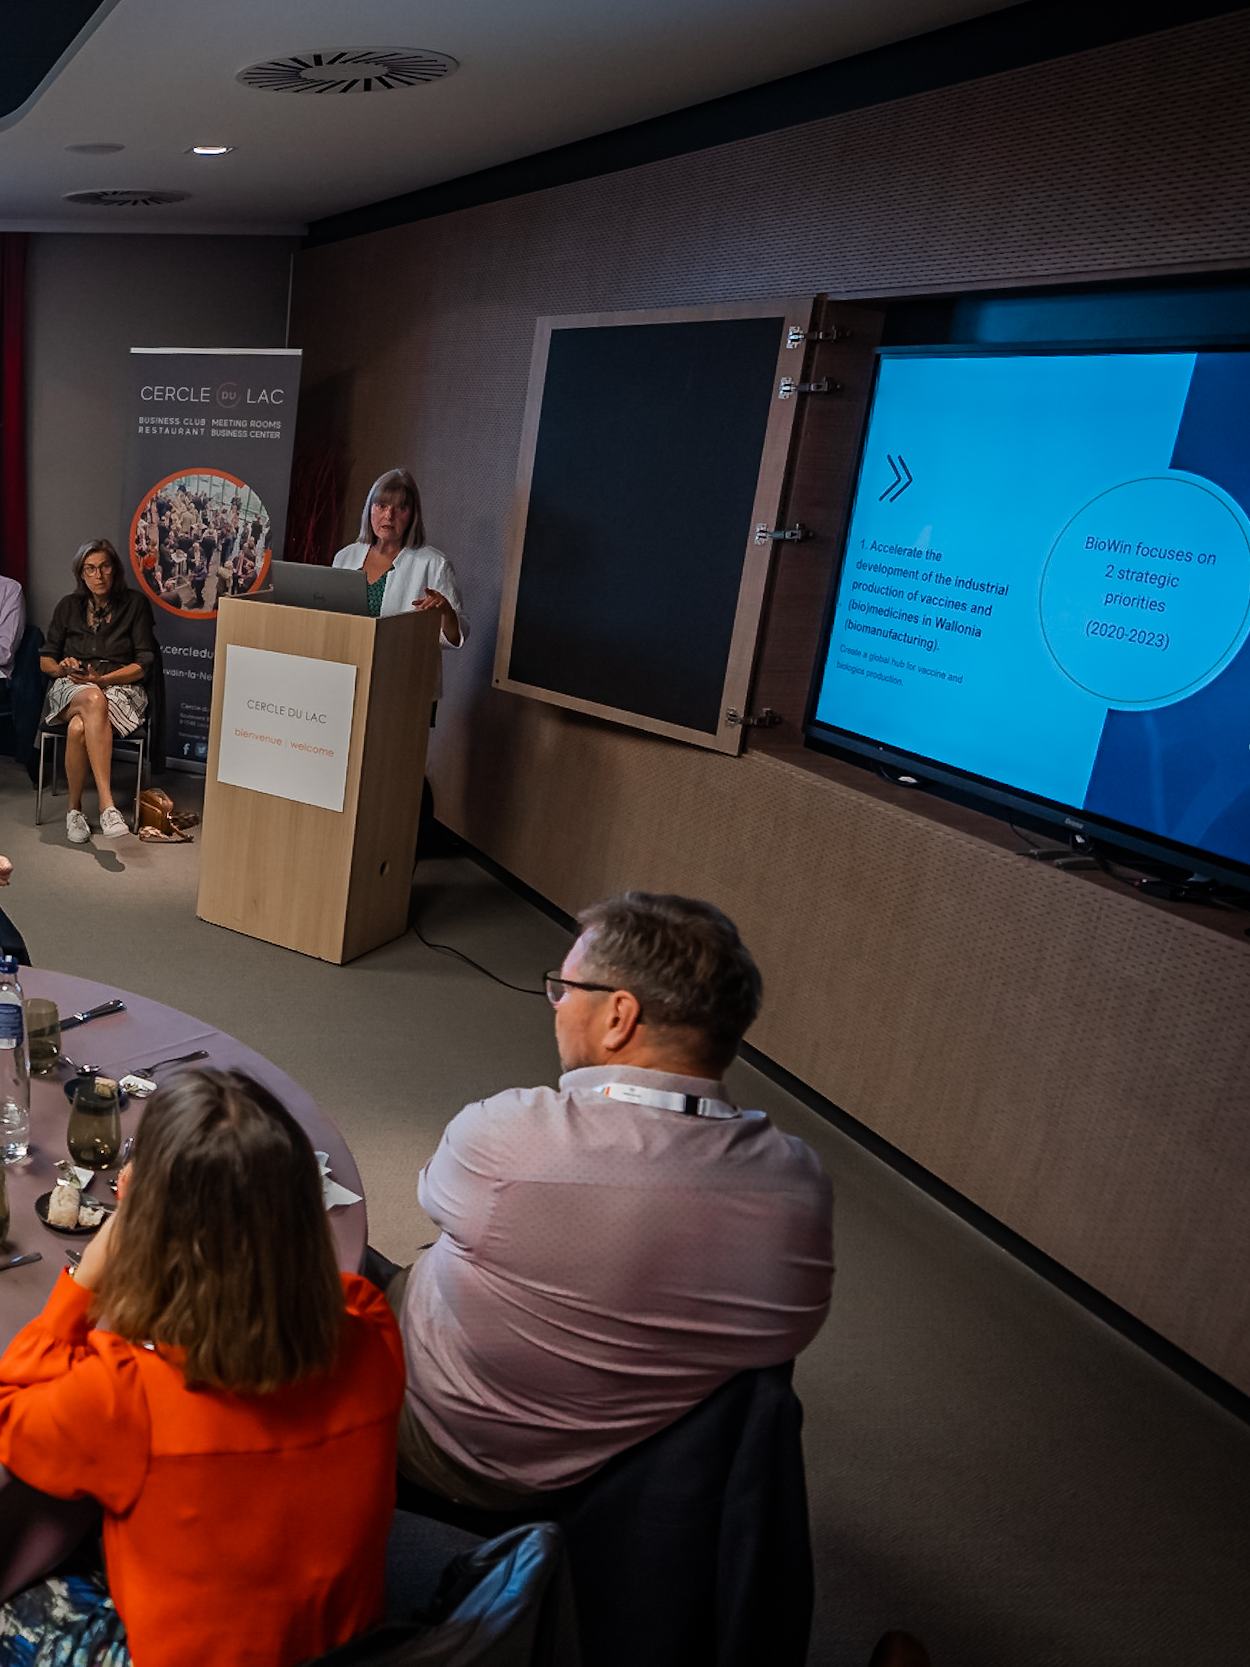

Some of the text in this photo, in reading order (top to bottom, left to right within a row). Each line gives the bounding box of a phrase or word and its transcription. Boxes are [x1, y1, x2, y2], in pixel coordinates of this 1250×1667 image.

[140, 386, 285, 404] CERCLE DU LAC
[138, 417, 282, 429] BUSINESS CLUB MEETING ROOMS
[138, 427, 281, 439] RESTAURANT BUSINESS CENTER
[860, 539, 942, 562] 1. Accelerate the
[1085, 536, 1216, 566] BioWin focuses on
[856, 559, 1010, 597] development of the industrial
[1105, 564, 1180, 589] 2 strategic
[852, 580, 993, 617] production of vaccines and
[1104, 592, 1166, 613] priorities
[848, 598, 982, 638] (bio)medicines in Wallonia
[844, 618, 940, 652] (biomanufacturing).
[1086, 619, 1170, 652] (2020-2023)
[836, 660, 904, 687] biologics production.
[840, 644, 862, 657] Create
[869, 651, 890, 664] global
[891, 656, 905, 668] hub
[906, 661, 916, 671] for
[918, 665, 946, 679] vaccine
[947, 672, 963, 684] and
[247, 699, 327, 724] CERCLE DU LAC
[234, 728, 335, 757] bienvenue welcome
